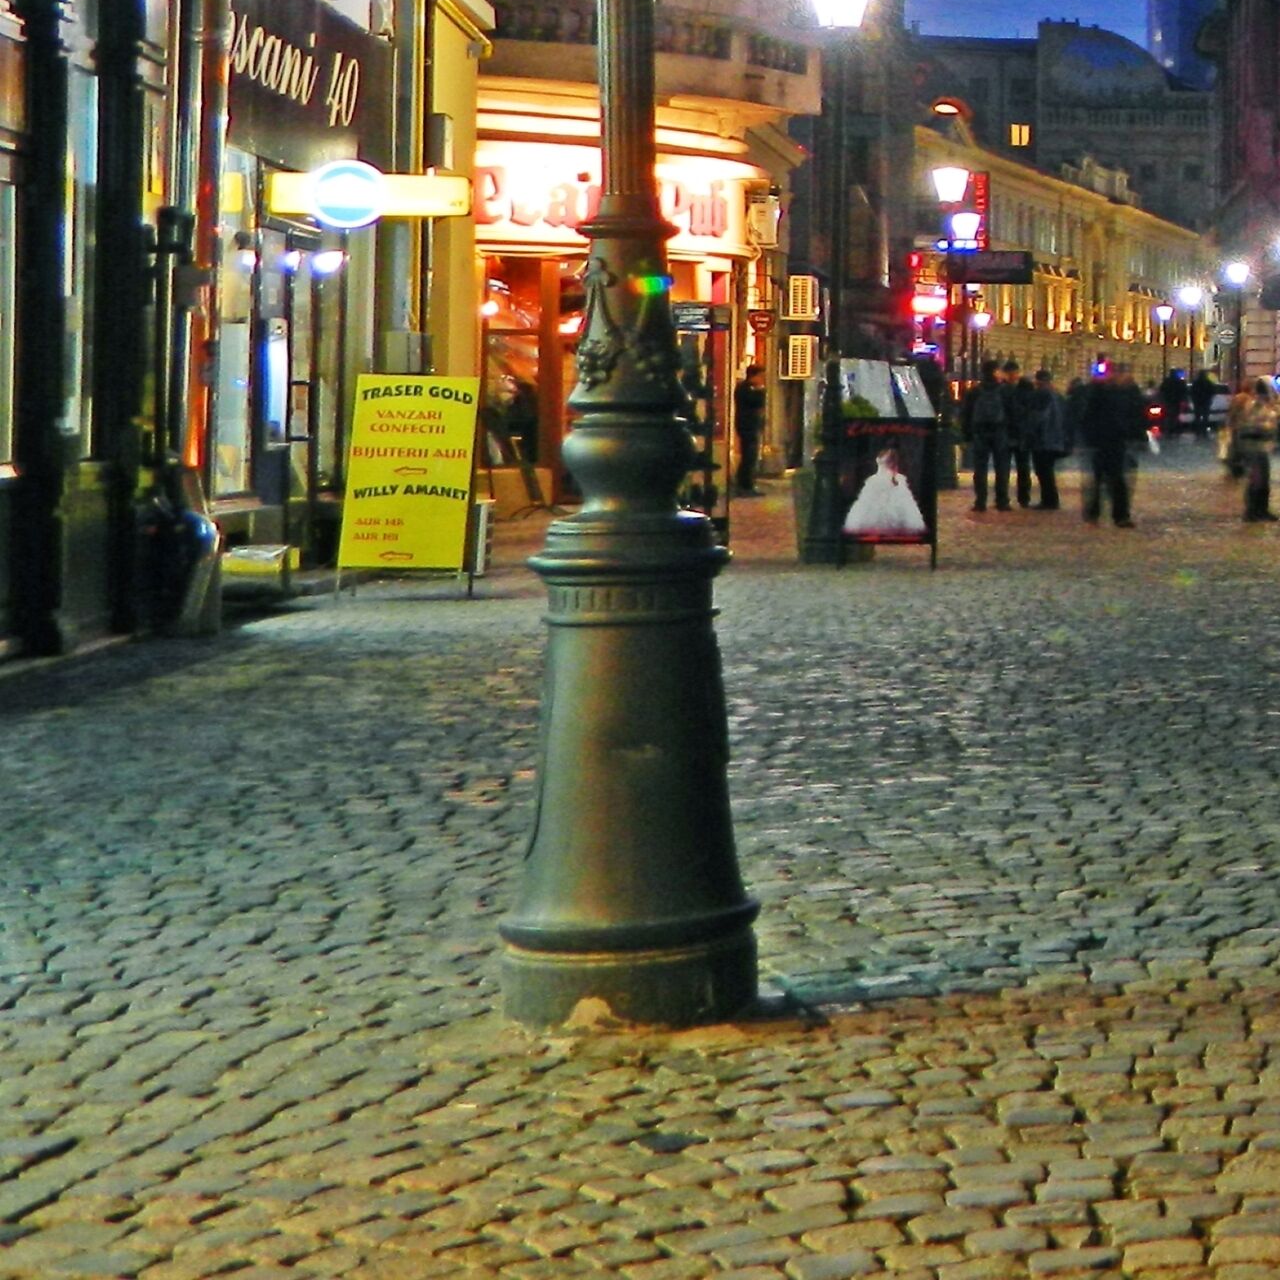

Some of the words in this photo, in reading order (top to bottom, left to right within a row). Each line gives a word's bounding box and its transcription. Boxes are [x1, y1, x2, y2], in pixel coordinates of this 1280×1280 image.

[326, 52, 360, 127] 40
[362, 384, 423, 401] TRASER
[428, 386, 474, 405] GOLD
[375, 410, 442, 420] VANZARI
[369, 423, 446, 434] CONFECTII
[352, 446, 429, 459] BIJUTERII
[432, 448, 468, 459] AUR
[353, 485, 399, 500] WILLY
[403, 484, 468, 501] AMANET
